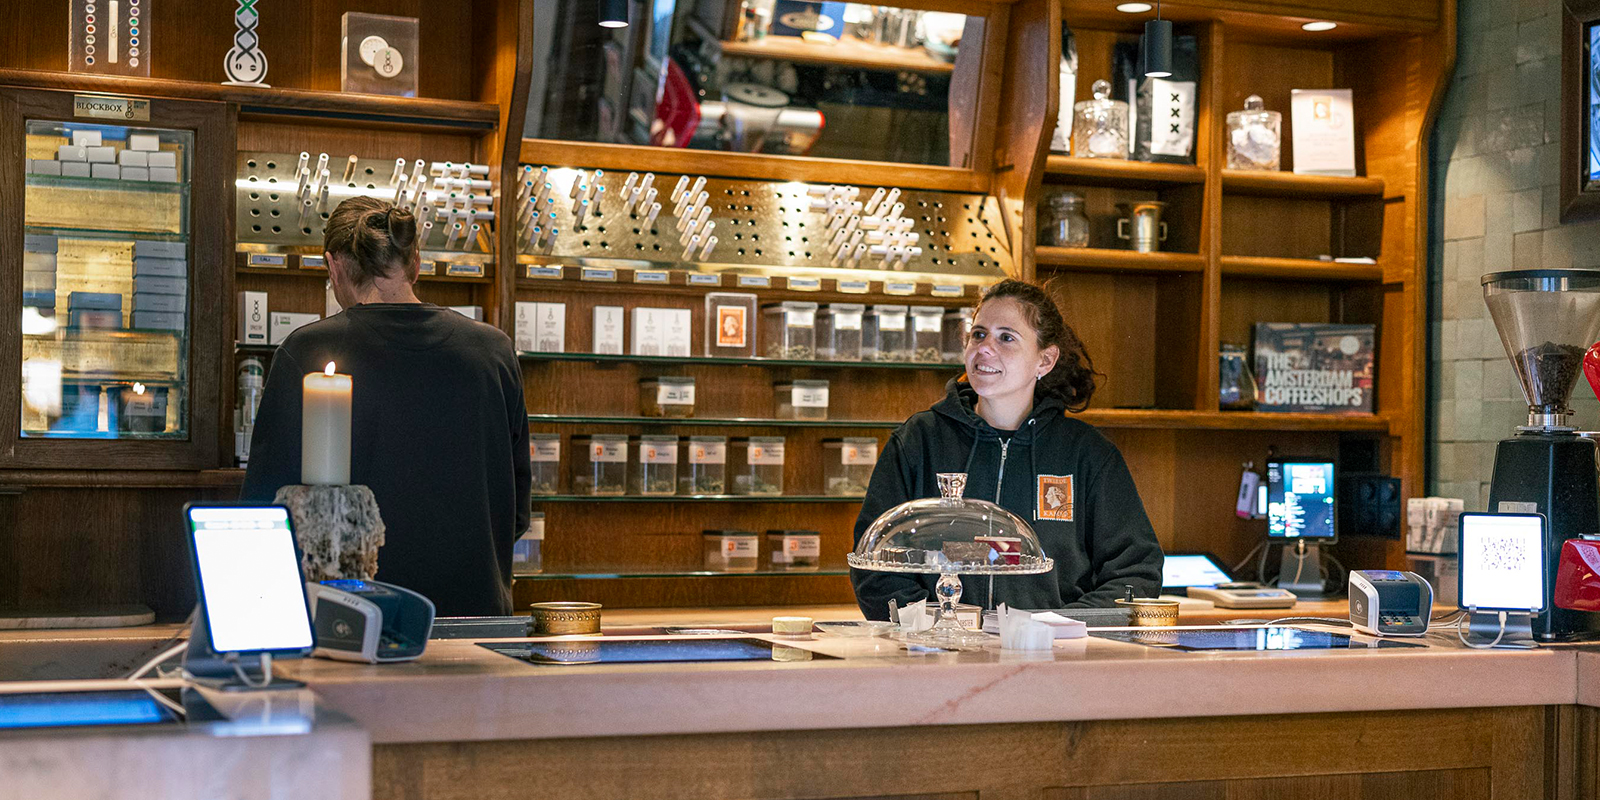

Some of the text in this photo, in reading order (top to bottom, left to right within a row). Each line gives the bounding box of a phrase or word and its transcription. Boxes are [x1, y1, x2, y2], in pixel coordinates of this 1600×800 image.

[76, 102, 122, 112] BLOCKBOX
[1267, 352, 1292, 369] THE
[1265, 370, 1352, 387] AMSTERDAM
[1266, 387, 1362, 405] COFFEESHOPS
